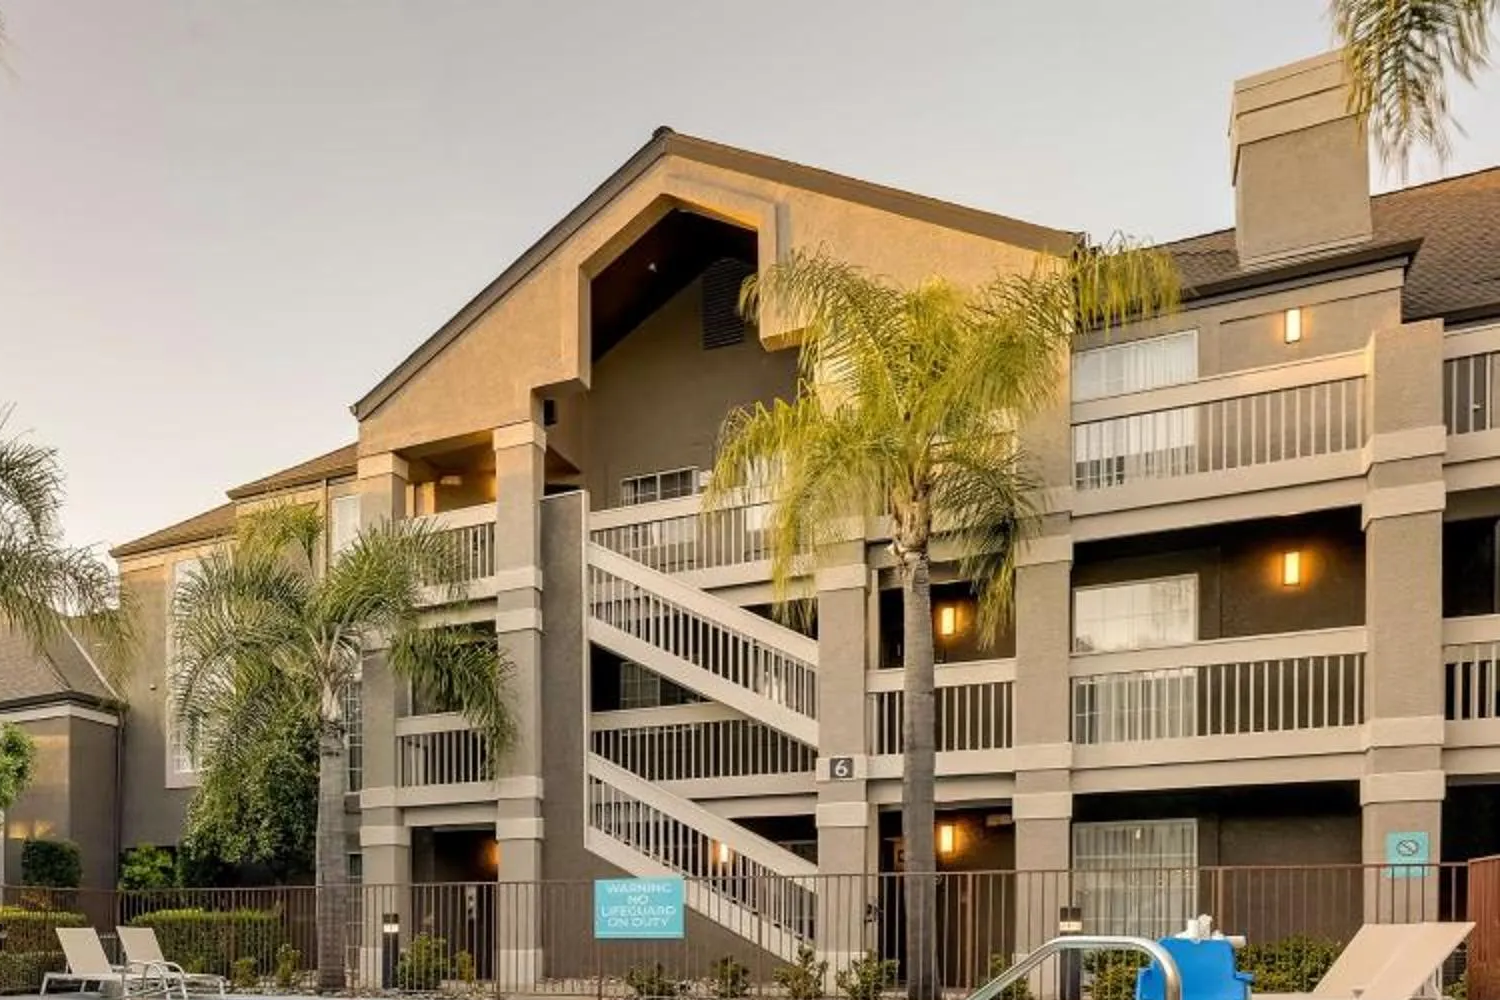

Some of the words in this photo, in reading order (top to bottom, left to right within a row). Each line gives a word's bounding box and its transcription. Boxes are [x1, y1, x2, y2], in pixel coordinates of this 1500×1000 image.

[835, 760, 848, 777] 6
[607, 883, 673, 894] WARNING
[627, 894, 649, 905] NO
[601, 905, 677, 918] LIFEGUARD
[607, 917, 629, 928] ON
[631, 917, 668, 928] DUTY
